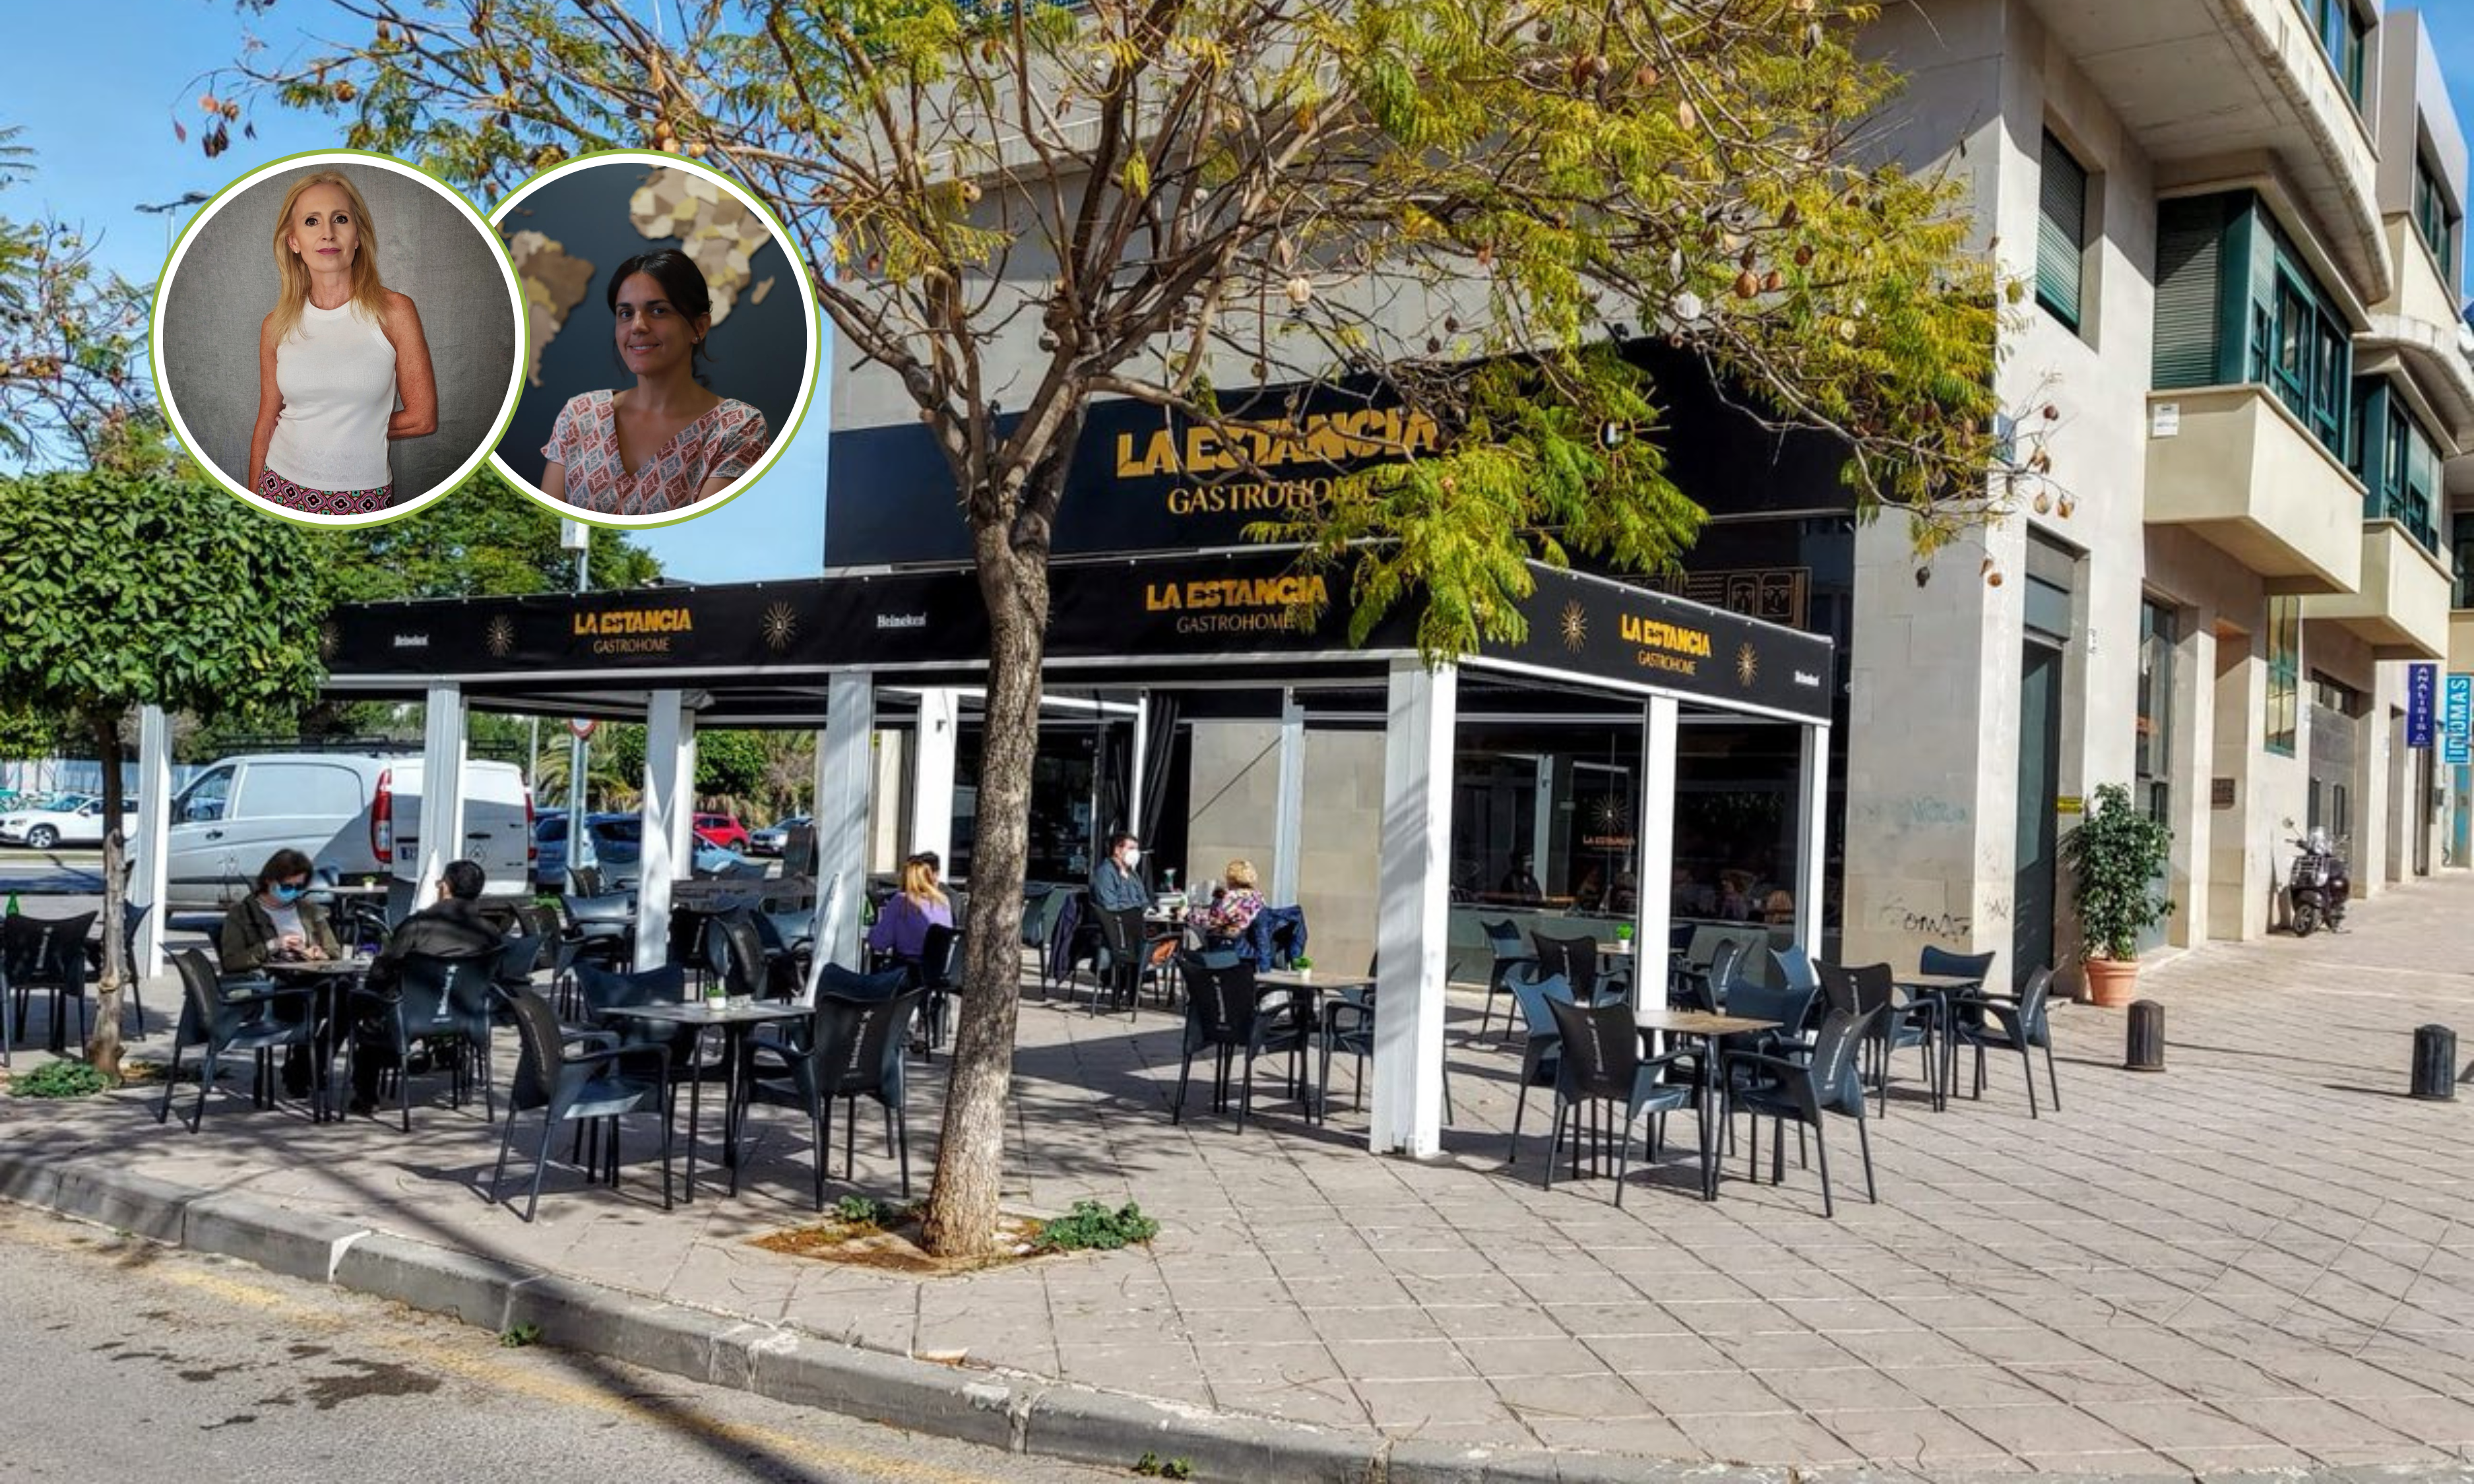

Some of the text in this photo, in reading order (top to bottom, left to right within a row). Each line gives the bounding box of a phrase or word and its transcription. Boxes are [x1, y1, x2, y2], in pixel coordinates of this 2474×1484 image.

[1117, 408, 1438, 478] LA ESTANCIA
[1147, 574, 1329, 611] LA ESTANCIA
[574, 607, 693, 635] LA ESTANCIA
[1622, 613, 1712, 658] LA ESTANCIA
[594, 637, 670, 654] GASTROHOME
[1638, 649, 1697, 677] GASTROHOME
